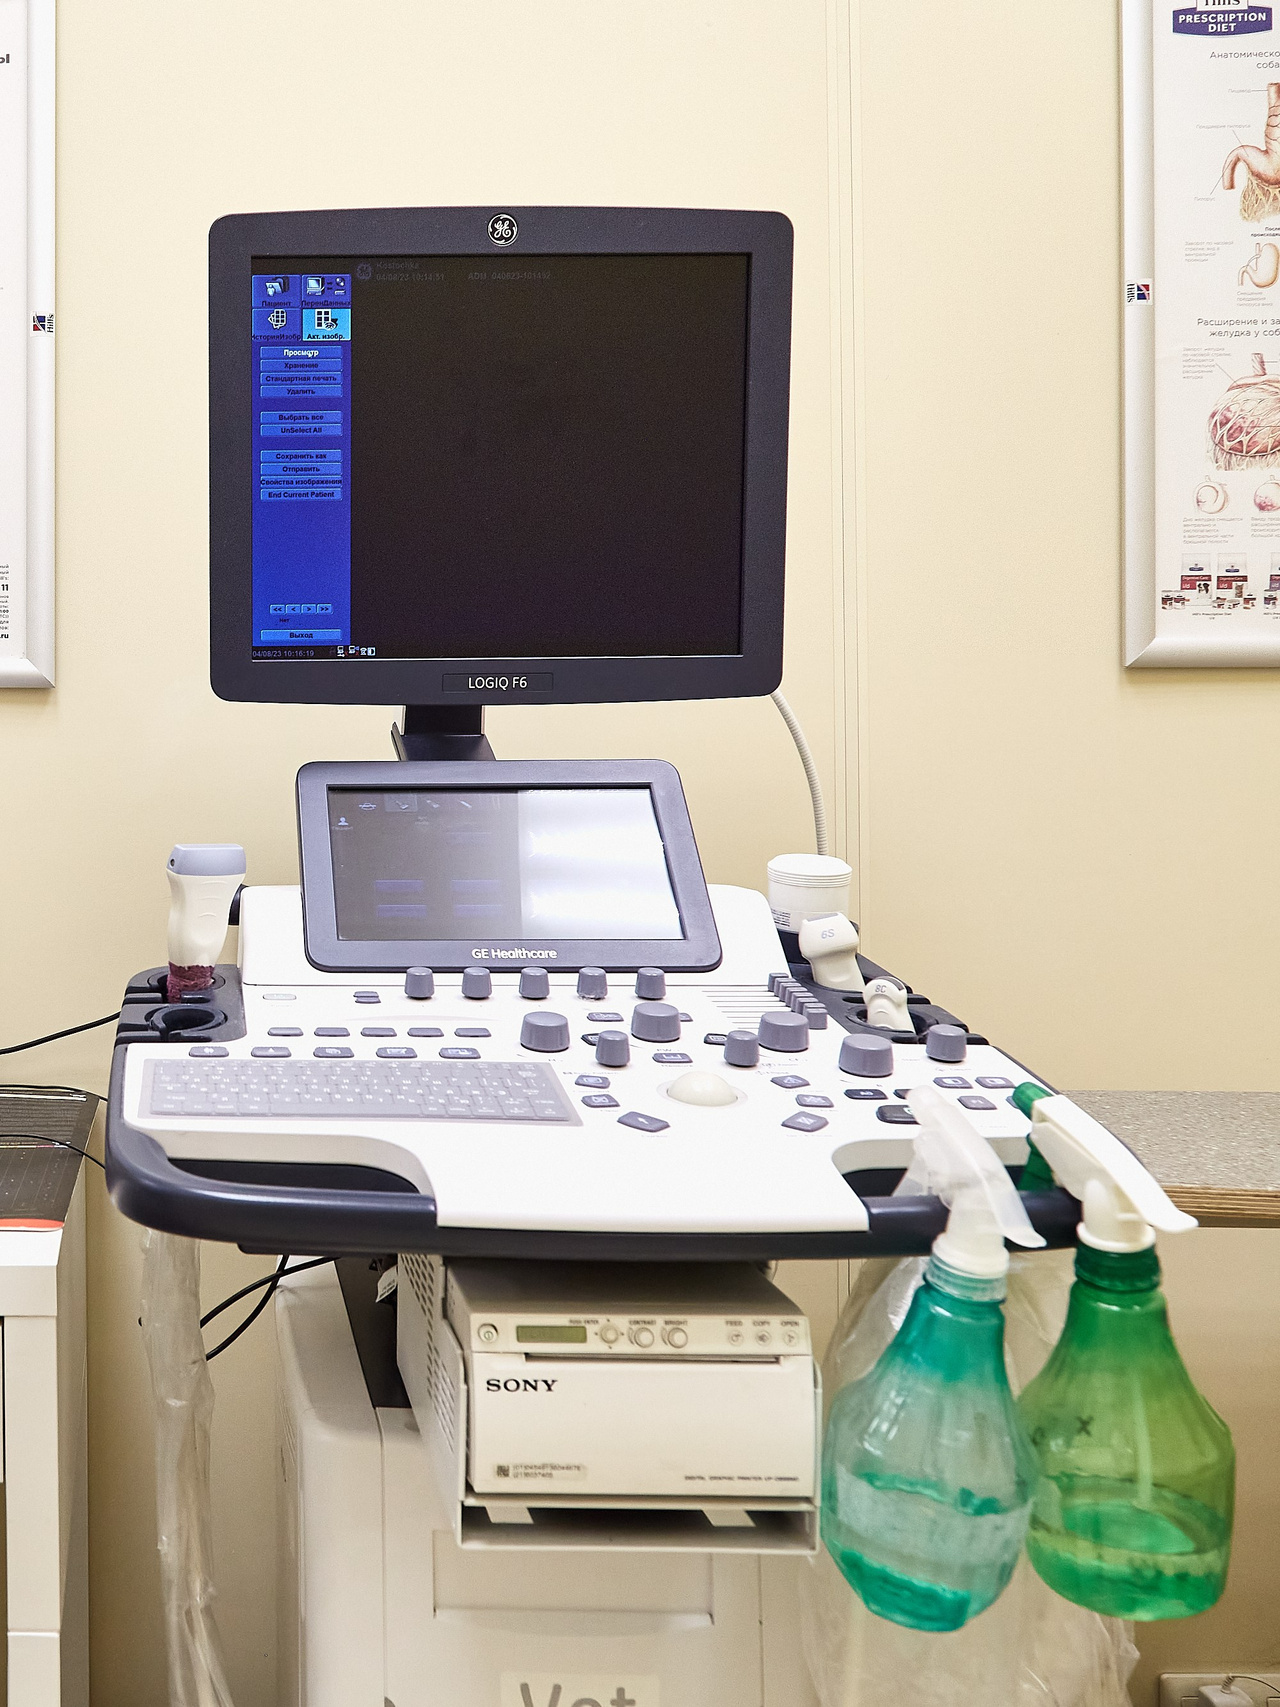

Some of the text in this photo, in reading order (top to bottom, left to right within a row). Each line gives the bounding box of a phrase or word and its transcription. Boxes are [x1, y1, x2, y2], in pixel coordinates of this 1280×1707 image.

[1179, 13, 1266, 23] PRESCRIPTION
[1208, 23, 1237, 32] DIET
[46, 313, 54, 333] Hill's
[1197, 317, 1258, 326] Расширение
[322, 333, 345, 341] изобр.
[1209, 329, 1251, 338] желудка
[1254, 330, 1260, 338] у
[283, 349, 319, 357] Просмотр
[287, 388, 316, 396] Удалить
[278, 414, 310, 422] Выбрать
[275, 453, 315, 461] Сохранить
[282, 466, 320, 474] Отправить
[295, 478, 342, 487] изображения
[468, 676, 528, 690] LOGIQ F6
[821, 928, 835, 940] 6S
[471, 948, 558, 959] GE Healthcare
[486, 1379, 558, 1392] SONY
